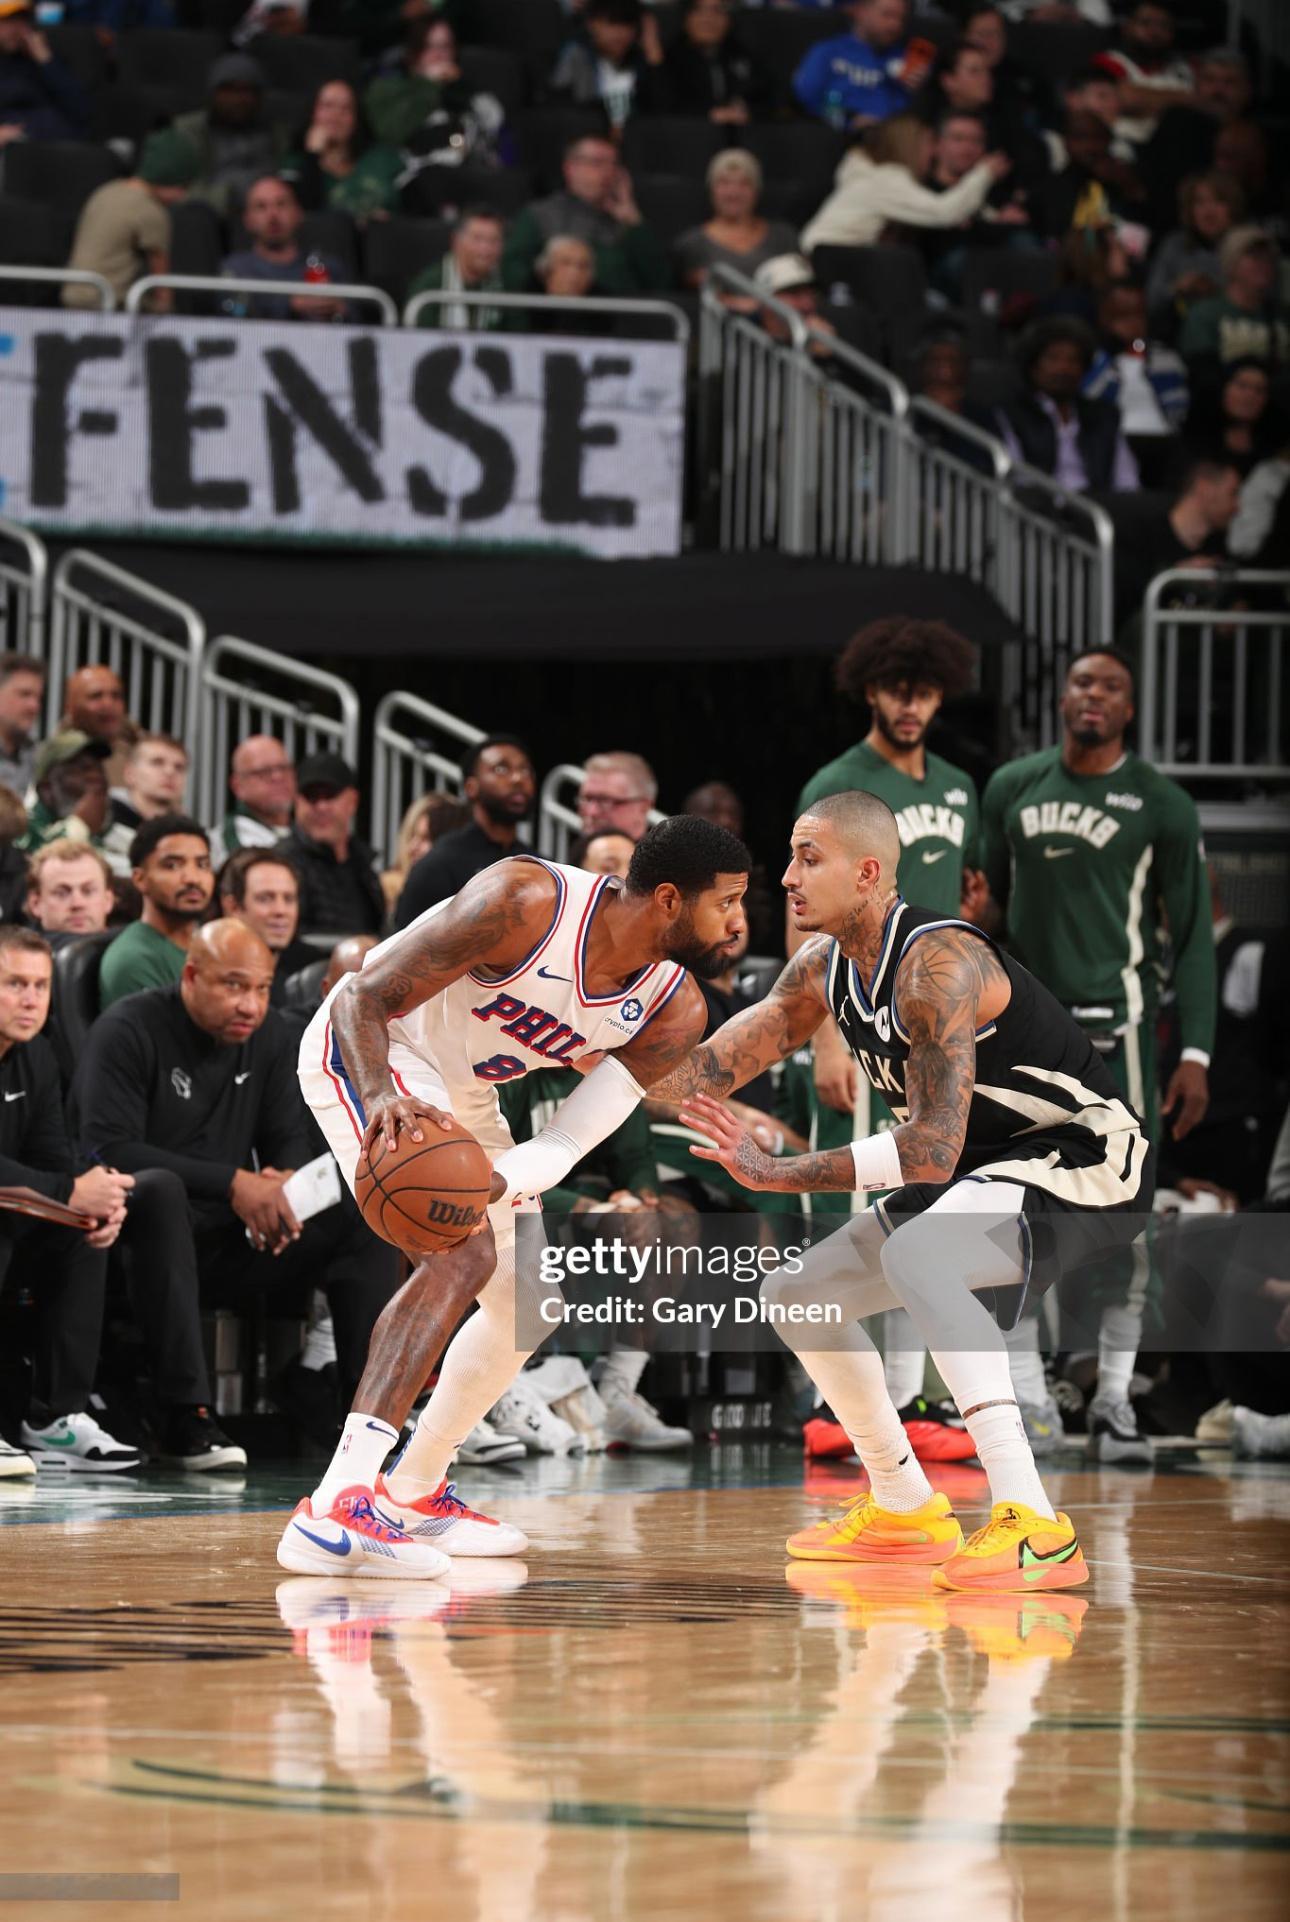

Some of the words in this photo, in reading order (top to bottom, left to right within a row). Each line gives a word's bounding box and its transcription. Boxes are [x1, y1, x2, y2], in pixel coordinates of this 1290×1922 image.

[0, 330, 638, 528] FENSE
[1020, 801, 1120, 850] BUCKS
[472, 1053, 527, 1082] 8
